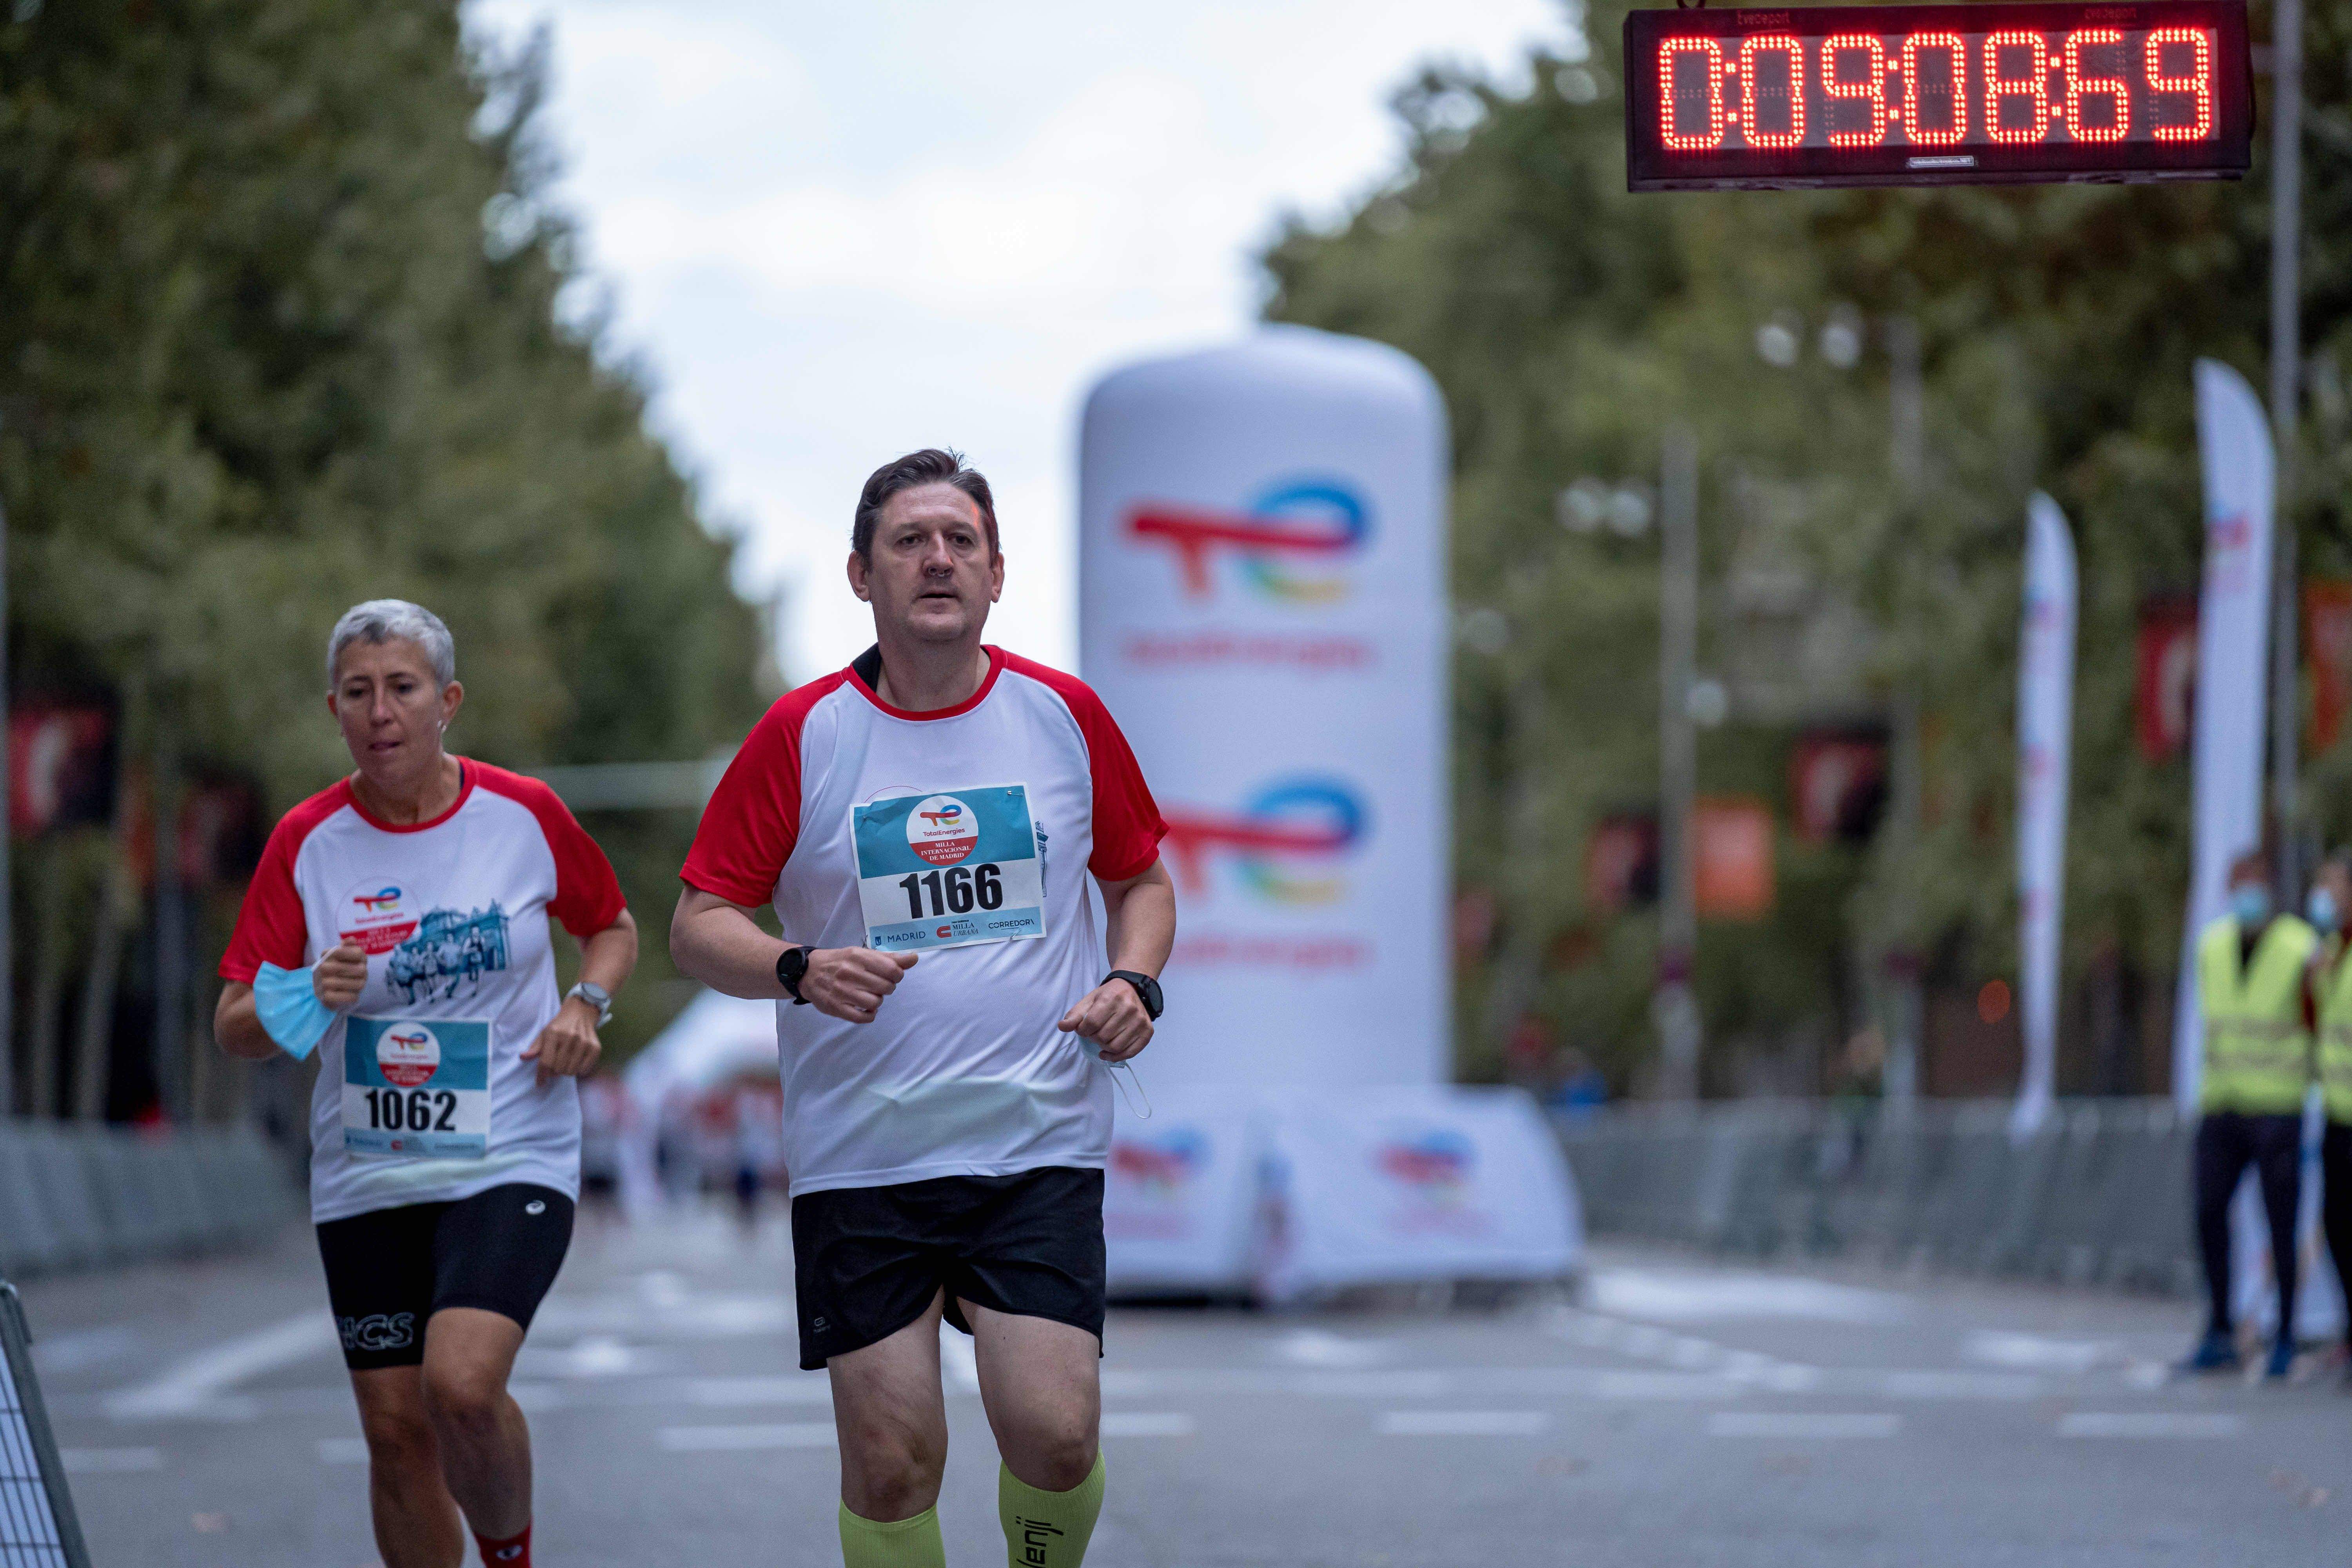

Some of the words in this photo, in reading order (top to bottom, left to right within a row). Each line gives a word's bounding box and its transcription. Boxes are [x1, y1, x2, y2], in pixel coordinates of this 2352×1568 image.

[923, 828, 965, 837] TotalEnergies
[899, 863, 1003, 919] 1166
[887, 931, 926, 943] MADRID
[953, 928, 978, 937] URBANA
[365, 1088, 457, 1131] 1062
